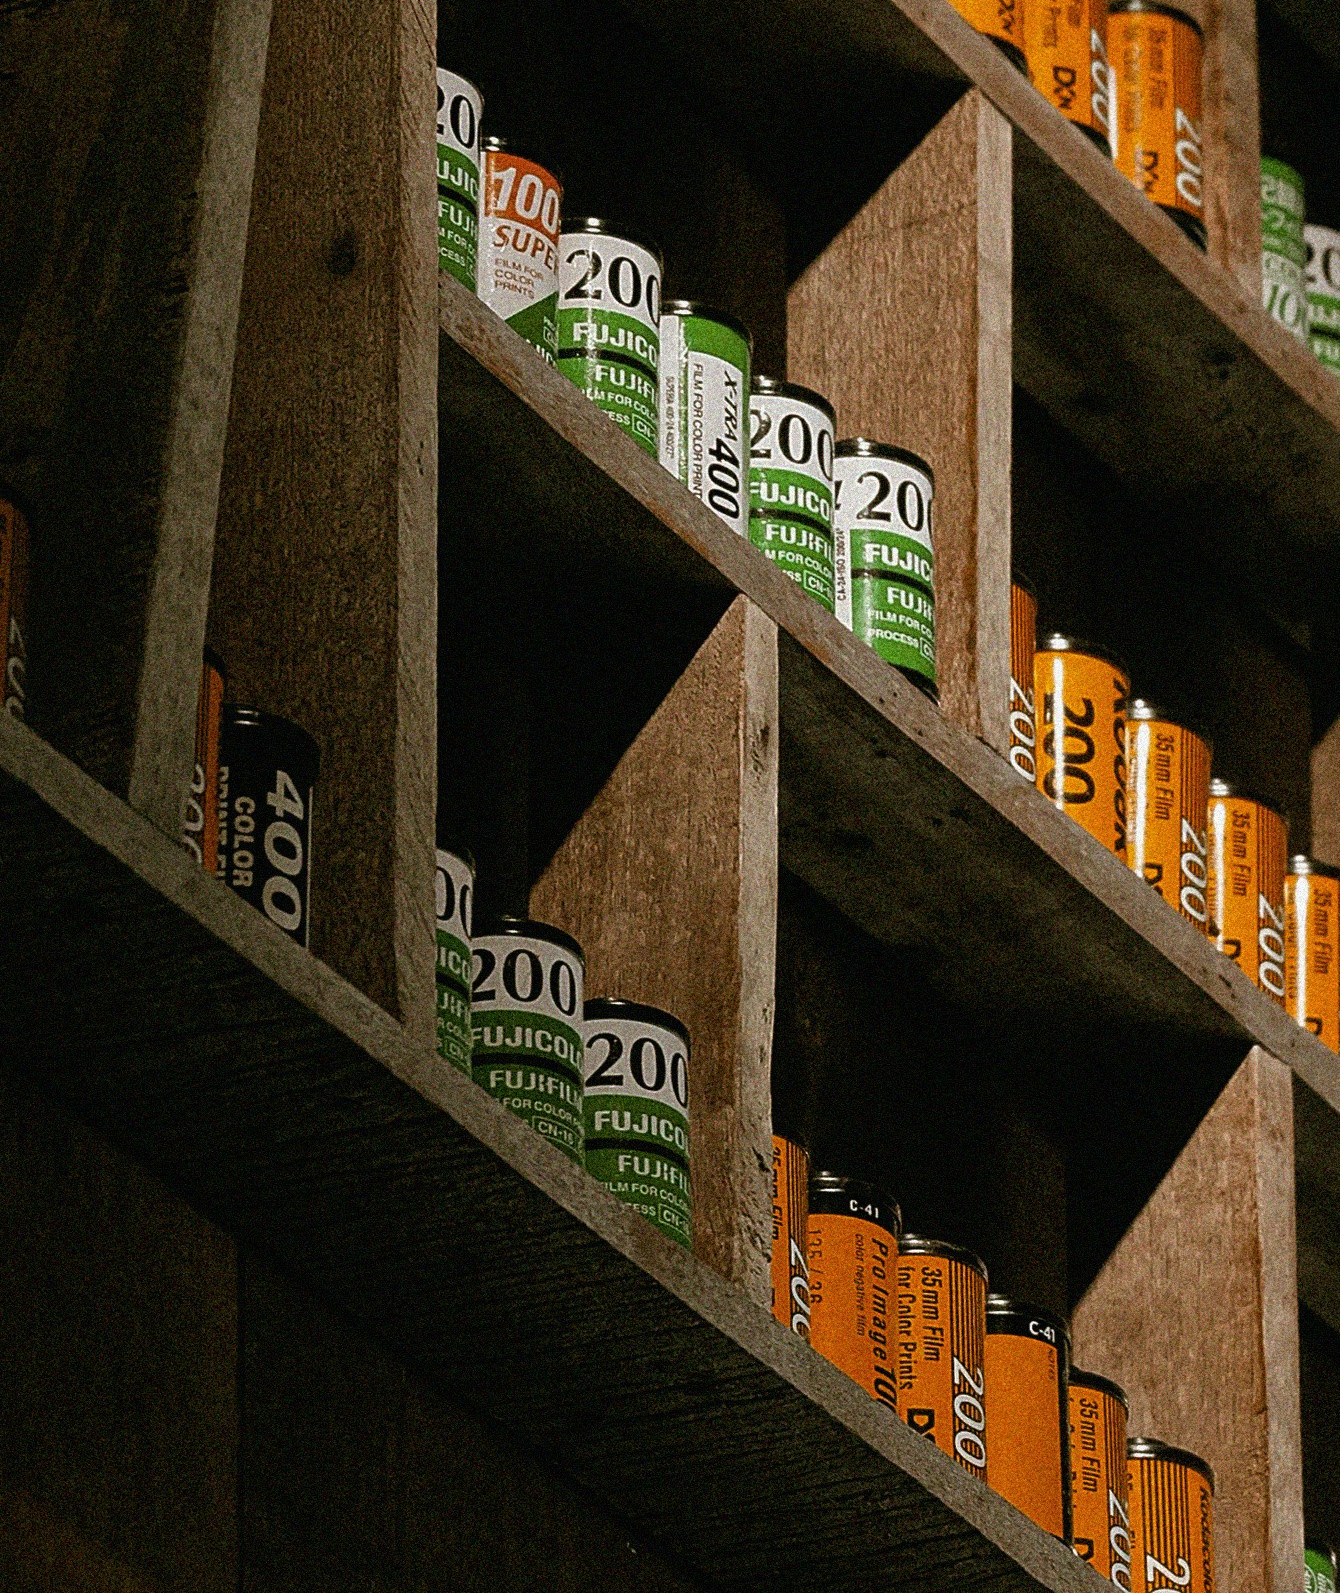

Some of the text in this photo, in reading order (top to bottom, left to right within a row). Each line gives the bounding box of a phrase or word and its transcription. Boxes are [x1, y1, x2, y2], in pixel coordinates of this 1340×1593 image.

[1175, 107, 1202, 207] 200
[493, 167, 559, 235] 100
[494, 270, 535, 289] COLOR
[494, 281, 536, 300] PRINTS
[495, 257, 545, 282] FILM FOR
[563, 249, 660, 328] 200
[692, 363, 704, 390] FILM
[692, 393, 704, 417] FOR
[692, 420, 704, 462] COLOR
[708, 370, 741, 519] X-TRA 400
[750, 410, 835, 481] 200
[856, 471, 931, 534] 20
[779, 550, 804, 565] FOR
[868, 628, 919, 648] PROCESS
[869, 609, 919, 632] FILM FOR
[1009, 677, 1037, 782] 200
[1043, 693, 1096, 804] 200
[232, 794, 256, 887] COLOR
[262, 769, 305, 931] 400
[1180, 817, 1207, 922] 200
[1258, 894, 1284, 996] 200
[471, 947, 576, 1017] 200
[585, 1032, 689, 1108] 200
[503, 1097, 573, 1124] FOR COLOR
[631, 1182, 658, 1198] FOR
[850, 1199, 880, 1220] C-41
[872, 1237, 889, 1280] Pro
[854, 1233, 867, 1337] color negative film
[868, 1284, 889, 1360] Image
[898, 1293, 917, 1338] Color
[1029, 1321, 1057, 1344] C-41
[898, 1341, 918, 1390] Prints
[922, 1326, 944, 1362] Film
[953, 1356, 985, 1468] 200
[1081, 1456, 1101, 1493] Film
